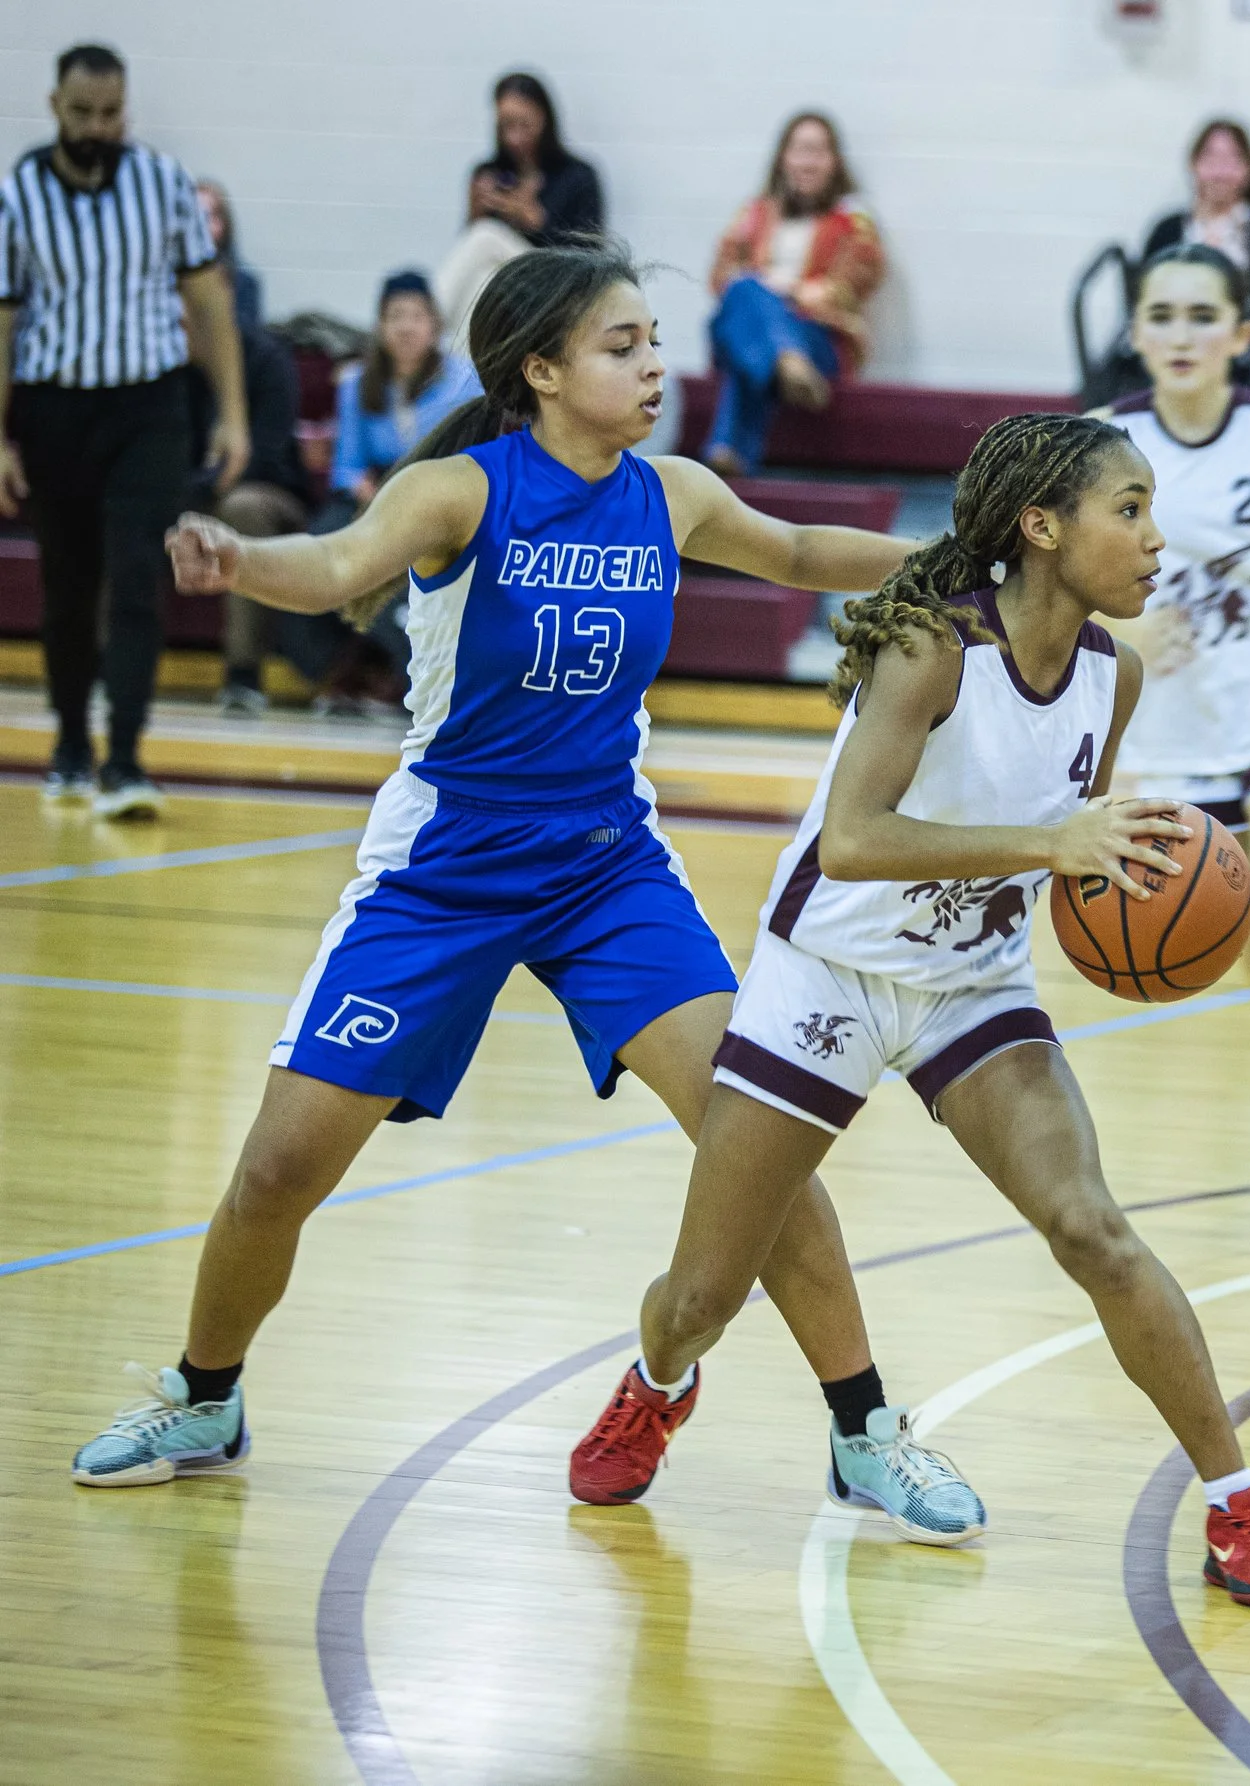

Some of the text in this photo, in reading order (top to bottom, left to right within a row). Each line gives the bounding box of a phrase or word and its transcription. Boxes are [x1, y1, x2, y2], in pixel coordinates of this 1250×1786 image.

[498, 539, 663, 591] PAIDEIA
[522, 604, 625, 695] 13
[1068, 733, 1094, 799] 4
